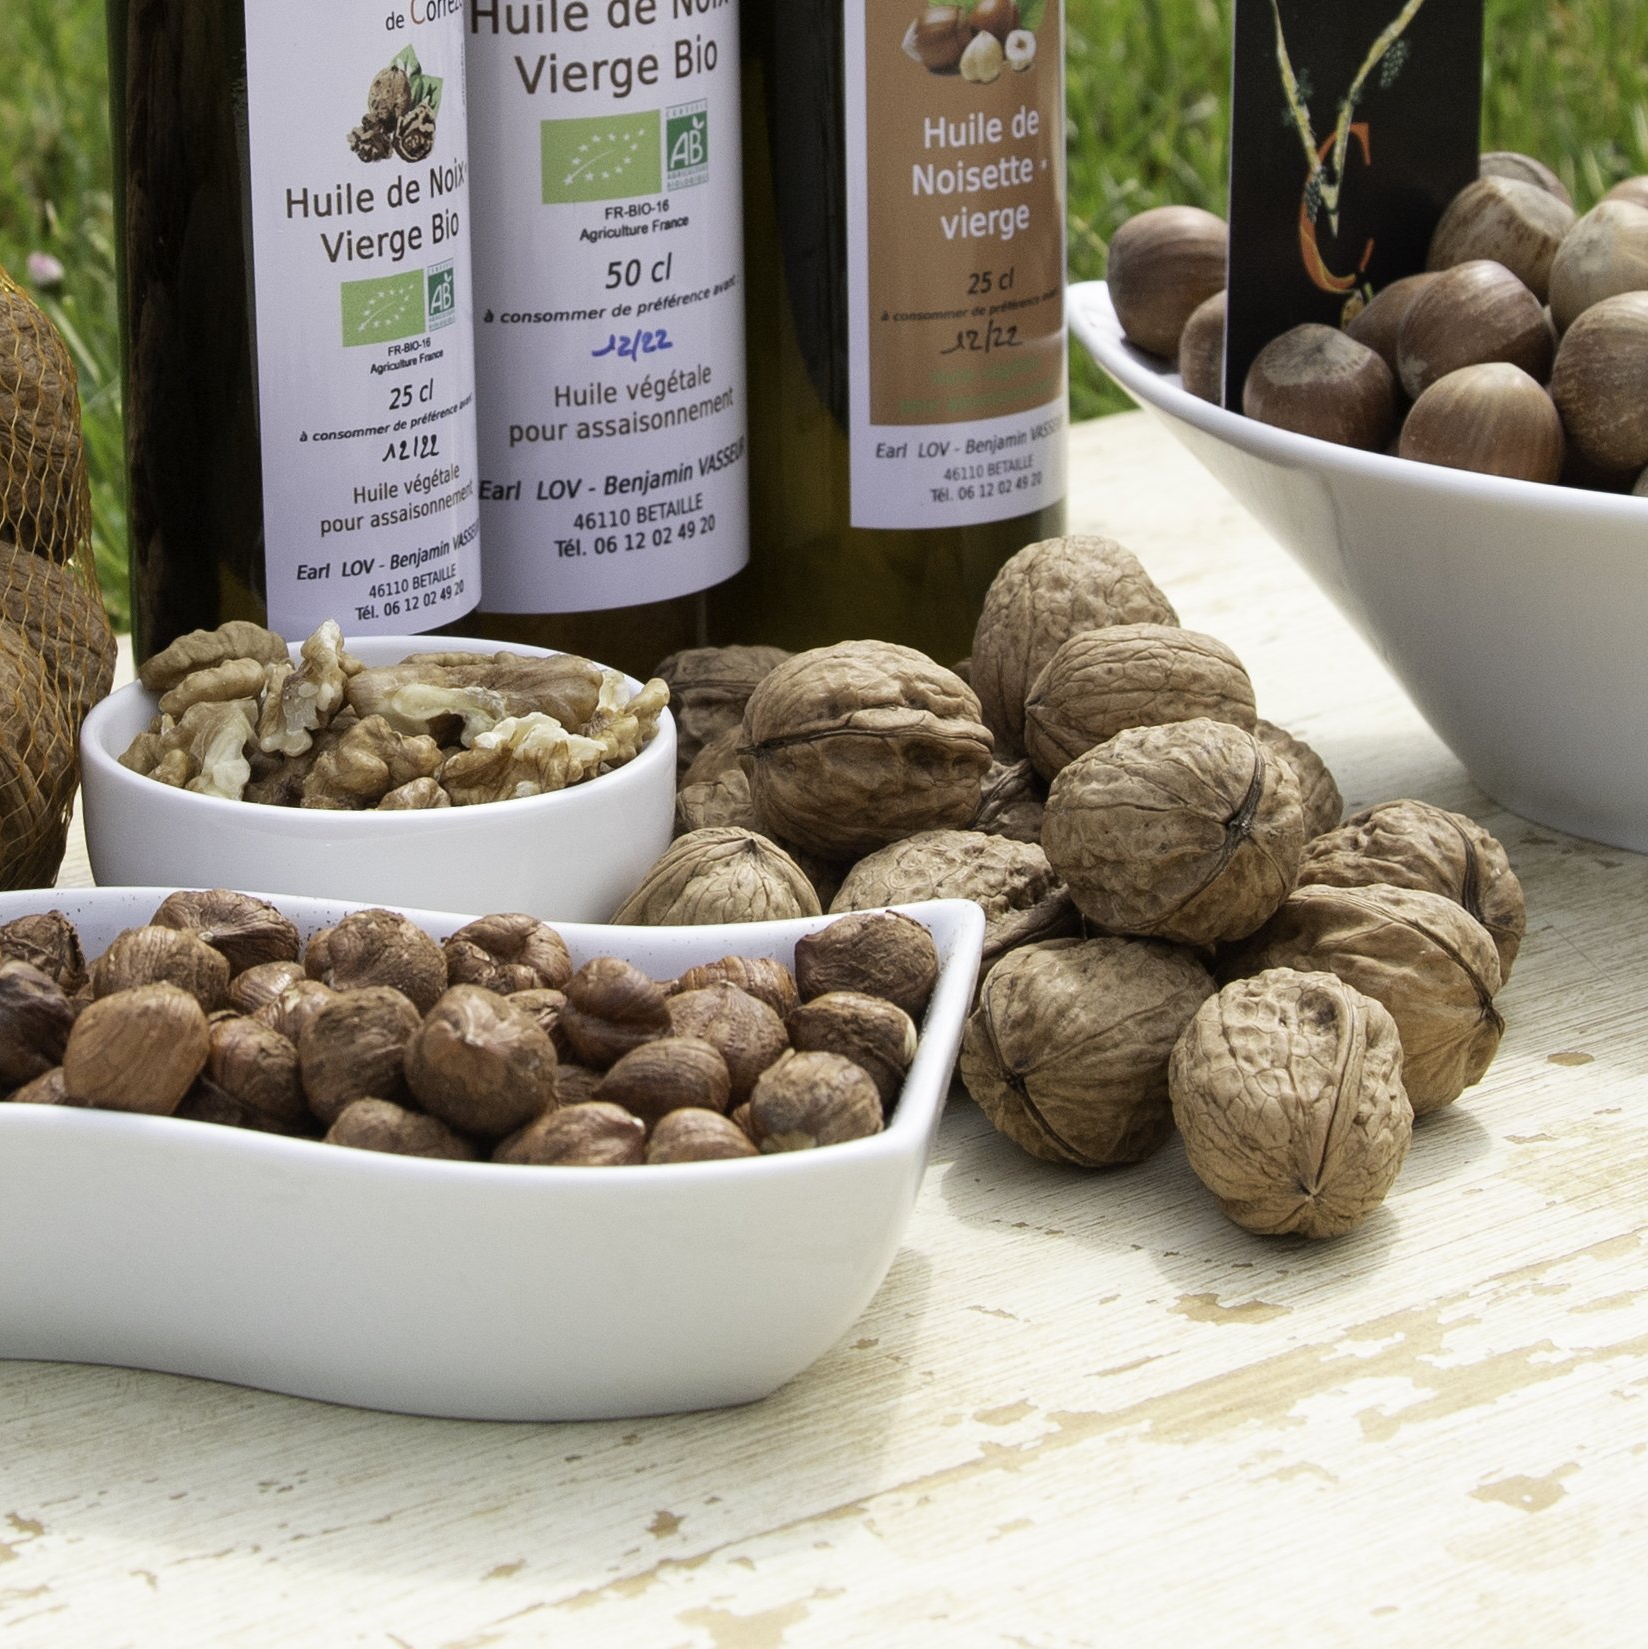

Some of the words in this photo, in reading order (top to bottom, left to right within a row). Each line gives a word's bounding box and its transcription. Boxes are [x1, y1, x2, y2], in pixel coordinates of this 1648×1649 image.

[385, 11, 405, 31] de
[514, 54, 659, 99] Vierge
[675, 34, 718, 79] Bio
[924, 112, 1003, 149] Huile
[1011, 105, 1039, 139] de
[671, 129, 703, 169] AB
[912, 155, 1033, 196] Noisette
[286, 183, 375, 219] Huile
[387, 175, 420, 209] de
[605, 199, 670, 220] FR-BIO-16
[320, 226, 423, 263] Vierge
[431, 209, 459, 245] Bio
[580, 222, 649, 242] Agriculture
[652, 215, 689, 233] France
[940, 204, 1030, 241] vierge
[605, 258, 642, 290] 50
[651, 252, 673, 283] cl
[967, 271, 993, 295] 25
[999, 266, 1015, 291] cl
[483, 309, 494, 324] à
[500, 308, 606, 324] consommer
[611, 304, 632, 318] de
[636, 288, 711, 315] préférence
[387, 337, 431, 357] FR-BIO-16
[591, 329, 673, 362] 12/22
[940, 318, 1022, 354] 12/22
[370, 358, 418, 375] Agriculture
[389, 384, 413, 411] 25
[419, 377, 434, 402] cl
[554, 383, 617, 408] Huile
[626, 364, 712, 402] végétale
[299, 431, 308, 443] à
[312, 424, 391, 442] consommer
[393, 419, 408, 432] de
[410, 403, 458, 430] préférence
[509, 423, 568, 447] pour
[576, 387, 734, 440] assaisonnement
[875, 443, 907, 459] Earl
[917, 441, 951, 458] LOV
[965, 430, 1027, 456] Benjamin
[353, 482, 399, 504] Huile
[404, 463, 460, 495] végétale
[478, 480, 522, 501] Earl
[536, 478, 582, 501] LOV
[604, 463, 693, 498] Benjamin
[944, 464, 984, 482] 46110
[987, 454, 1034, 476] BETAILLE
[321, 515, 364, 537] pour
[370, 479, 473, 528] assaisonnement
[958, 485, 975, 500] 06
[979, 483, 994, 498] 12
[998, 479, 1012, 495] 02
[573, 509, 630, 531] 46110
[636, 492, 703, 525] BETAILLE
[554, 539, 588, 558] Tél.
[594, 536, 618, 555] 06
[624, 532, 646, 551] 12
[652, 527, 672, 547] 02
[677, 520, 696, 540] 49
[700, 514, 716, 535] 20
[297, 563, 330, 580] Earl
[341, 558, 375, 577] LOV
[390, 540, 450, 570] Benjamin
[369, 579, 409, 599] 46110
[412, 563, 456, 590] BETAILLE
[355, 606, 379, 621] Tél.
[384, 601, 400, 616] 06
[405, 596, 419, 612] 12
[423, 591, 437, 607] 02
[440, 586, 452, 601] 49
[455, 580, 464, 597] 20
